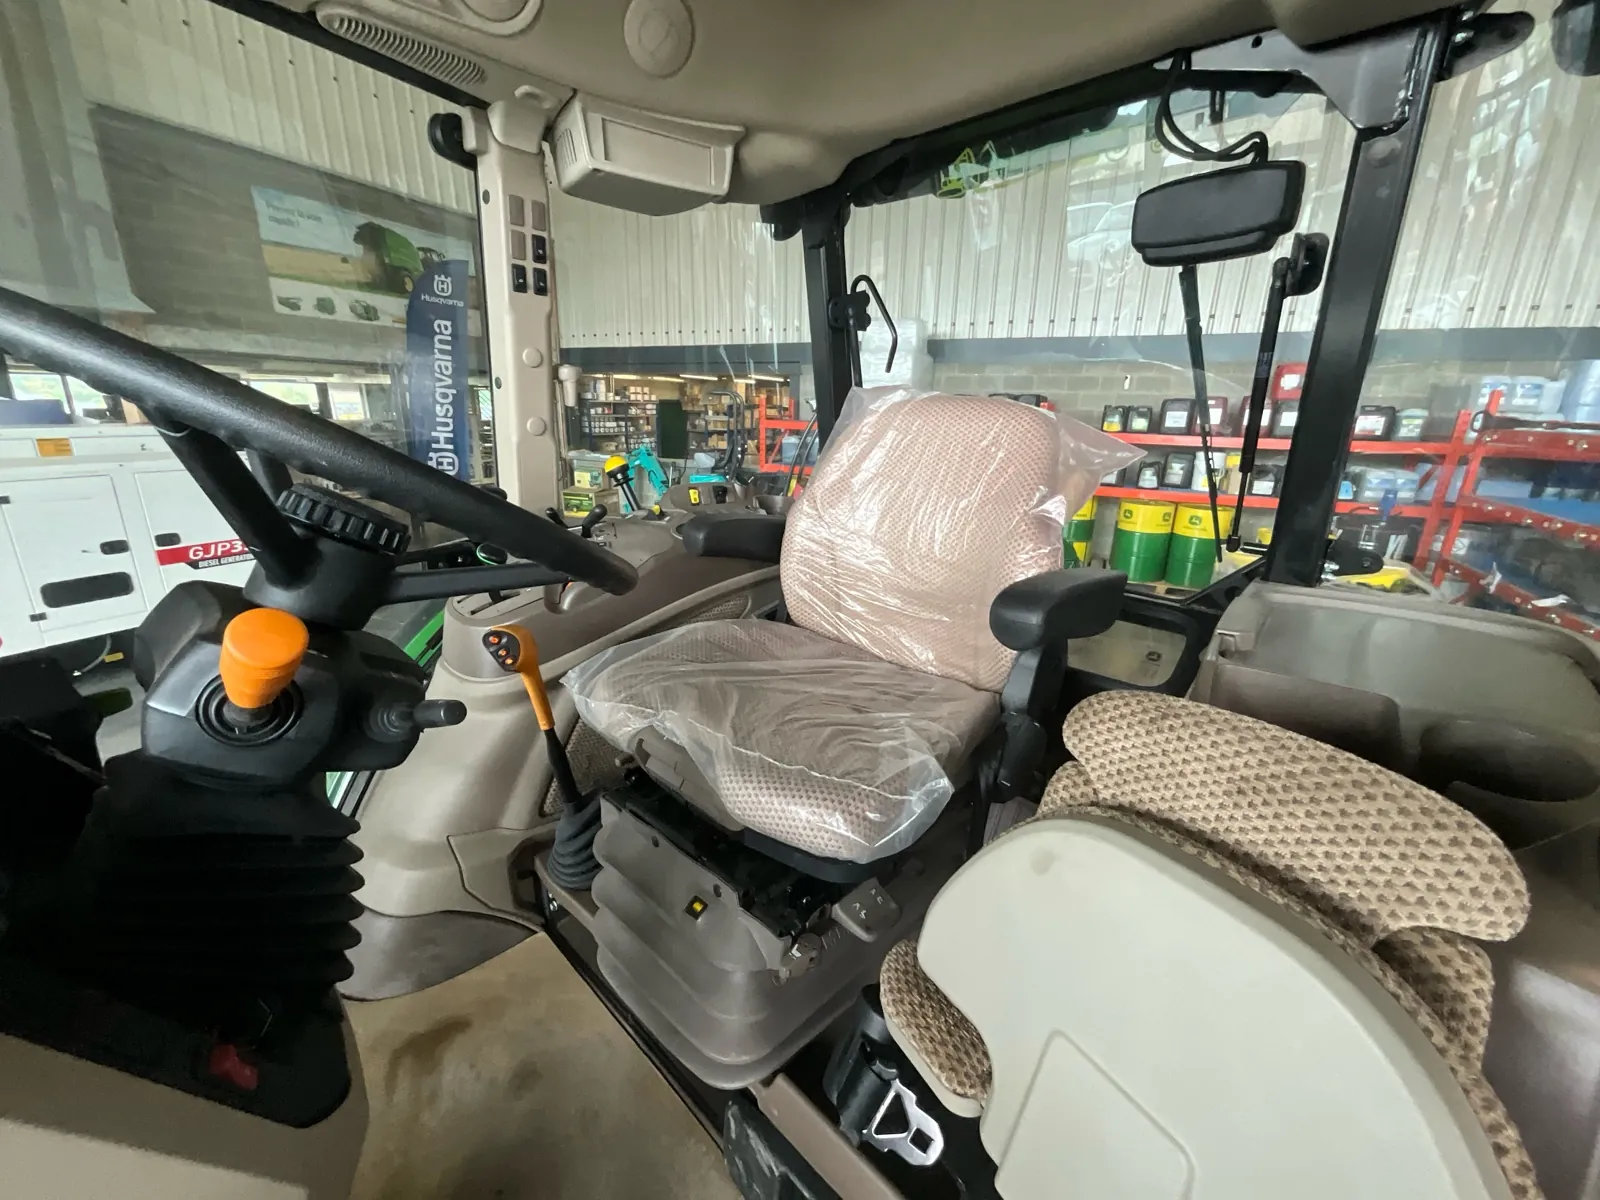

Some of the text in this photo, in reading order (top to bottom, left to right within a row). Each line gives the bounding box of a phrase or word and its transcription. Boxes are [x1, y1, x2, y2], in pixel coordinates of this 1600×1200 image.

[421, 293, 465, 307] Husqvarna
[431, 319, 457, 450] Husqvarna
[188, 540, 249, 559] GJP3
[198, 558, 220, 569] DIESEL
